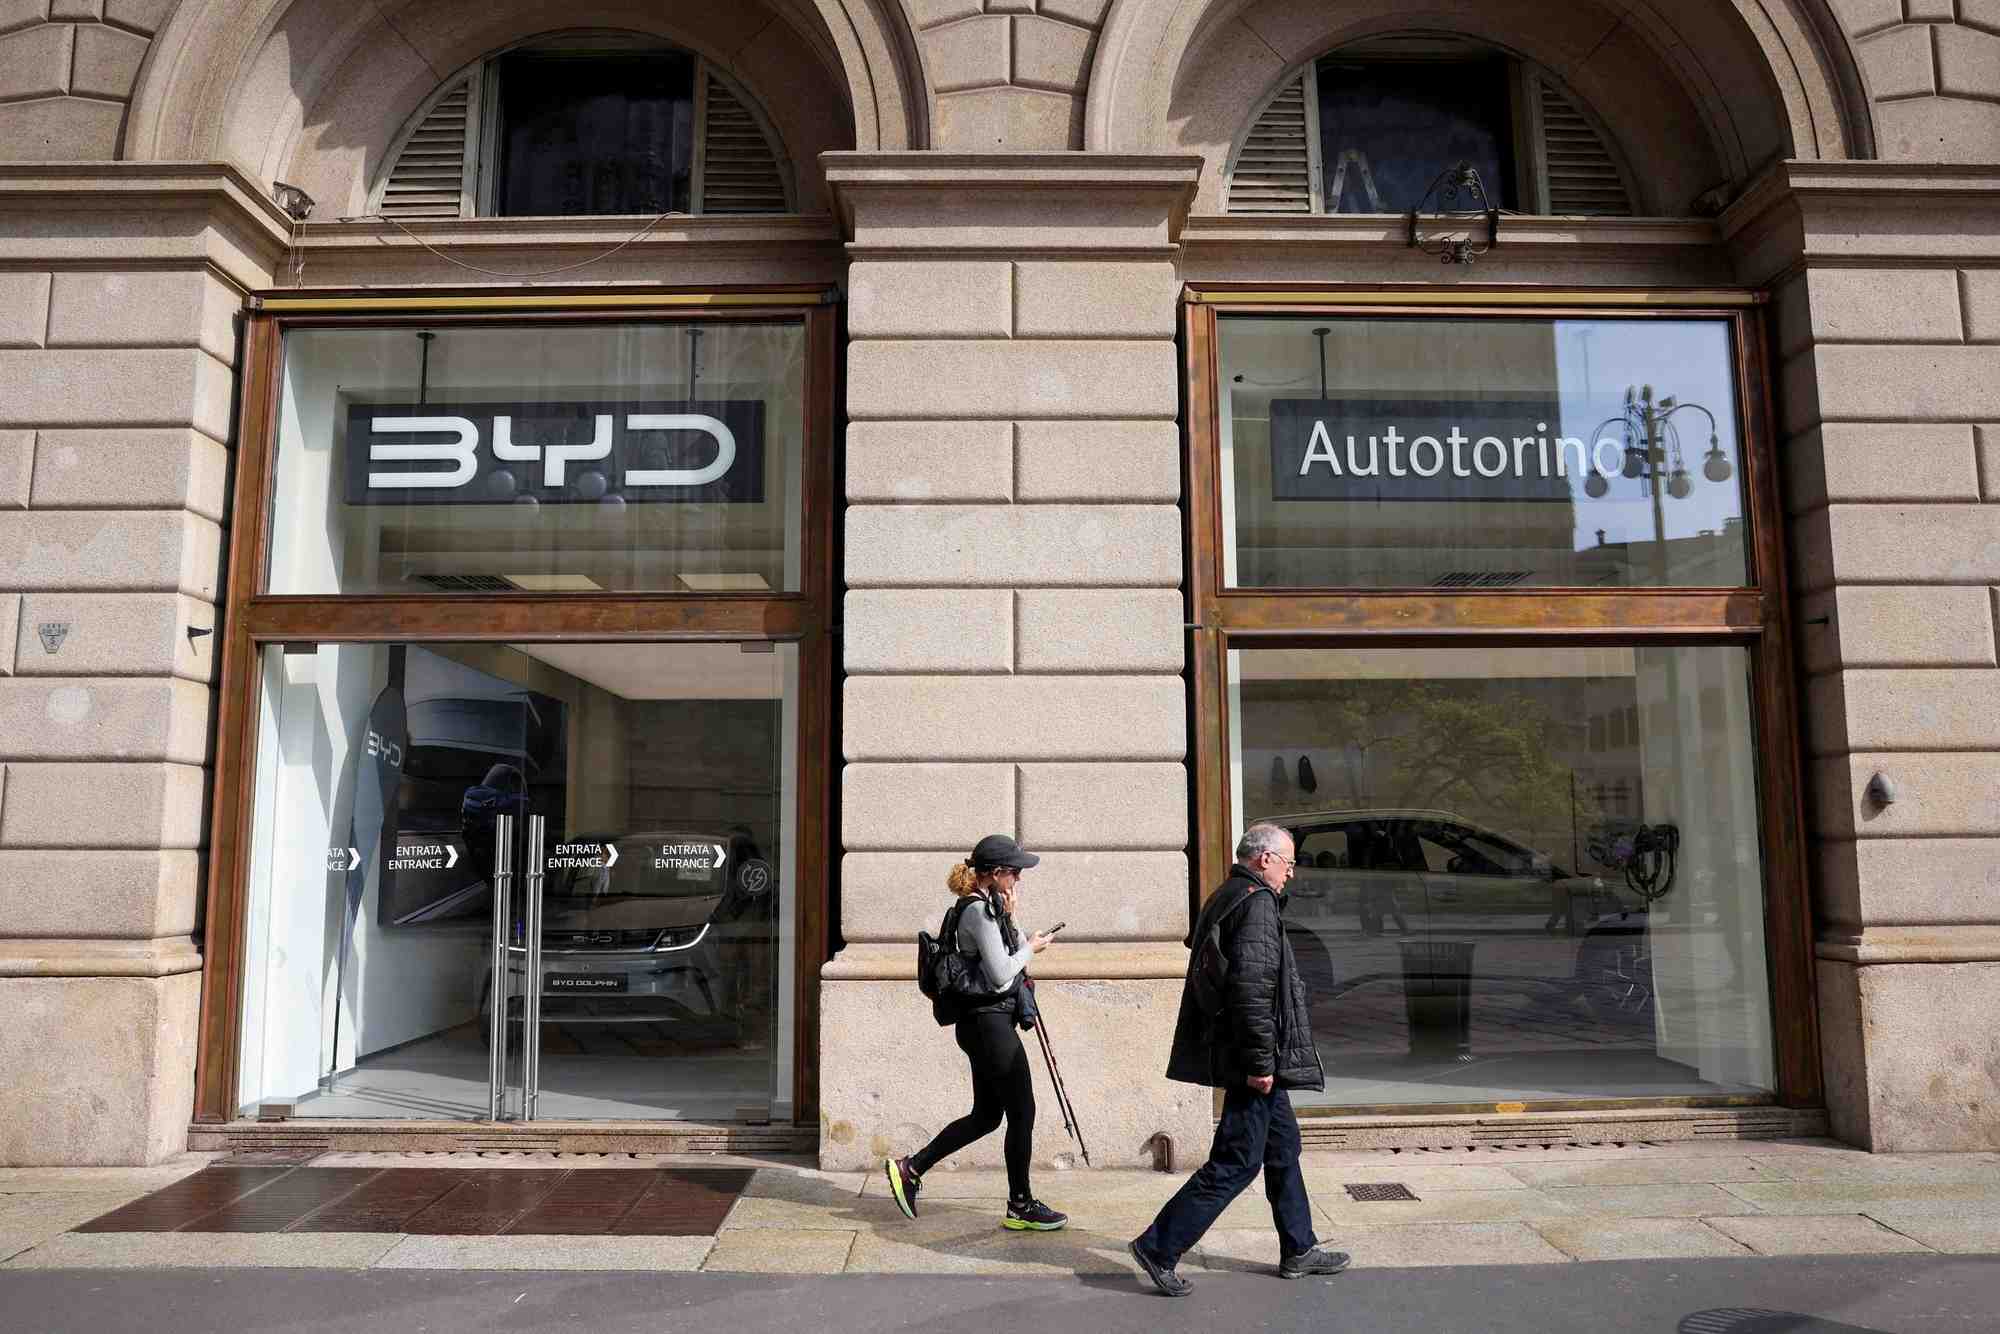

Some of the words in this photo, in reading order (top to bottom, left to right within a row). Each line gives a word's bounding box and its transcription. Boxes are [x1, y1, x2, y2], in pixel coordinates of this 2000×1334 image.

[368, 414, 737, 488] BYD
[1299, 420, 1627, 479] Autotorino
[367, 730, 401, 767] BYD
[396, 845, 443, 857] ENTRATA
[555, 844, 602, 855] ENTRATA
[662, 845, 711, 855] ENTRATA
[388, 858, 443, 870] ENTRANCE
[548, 857, 602, 869] ENTRANCE
[655, 858, 710, 869] ENTRANCE
